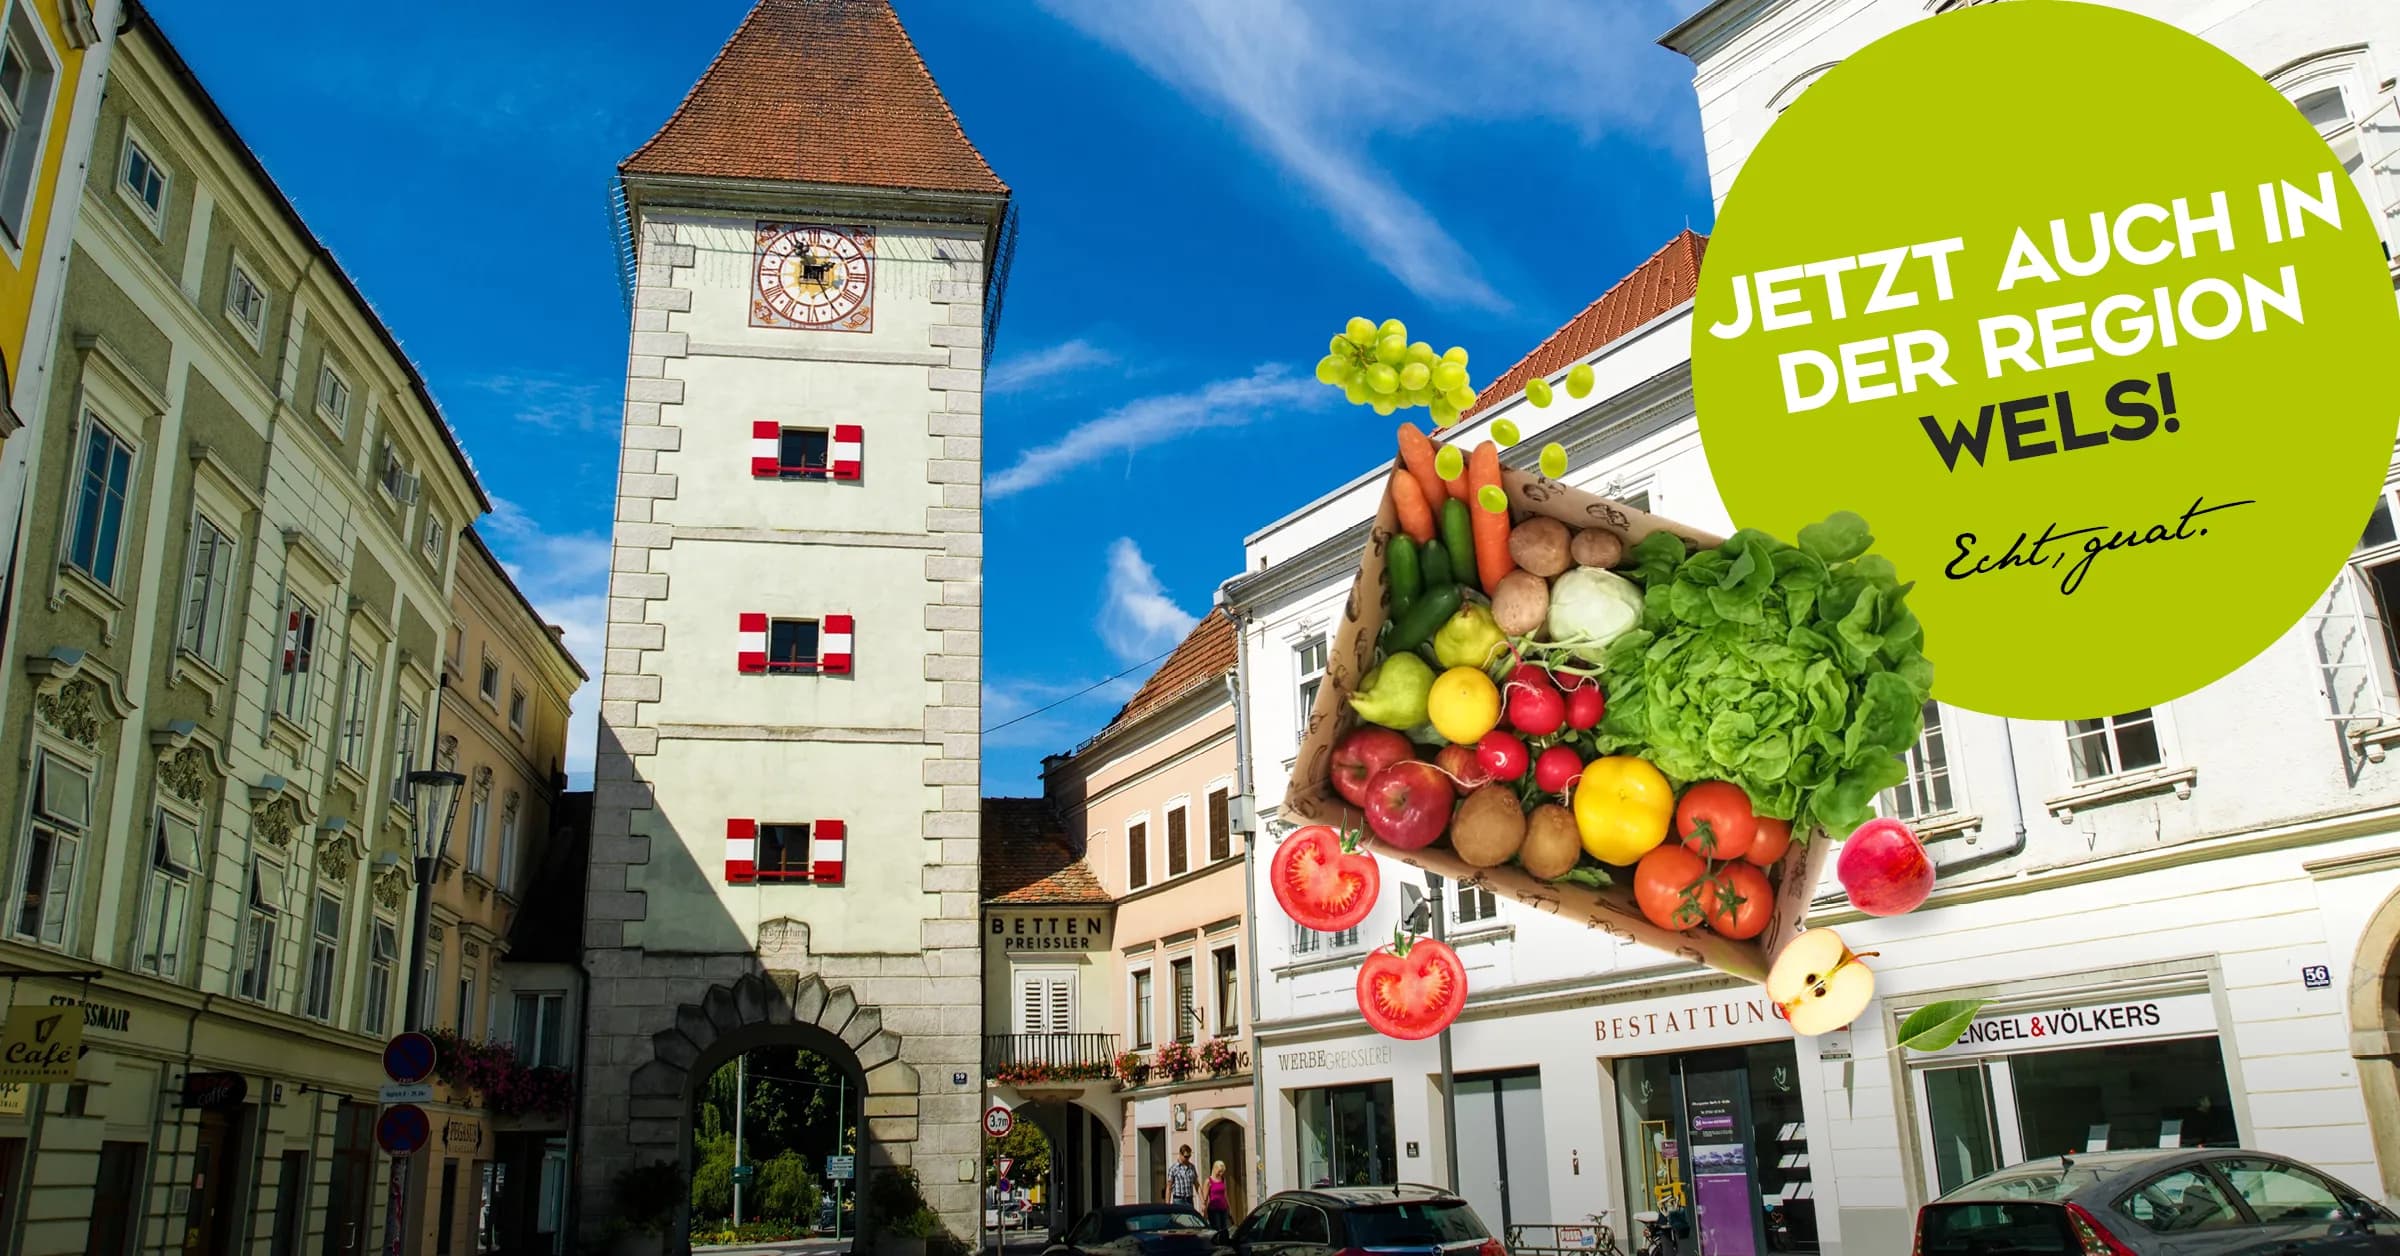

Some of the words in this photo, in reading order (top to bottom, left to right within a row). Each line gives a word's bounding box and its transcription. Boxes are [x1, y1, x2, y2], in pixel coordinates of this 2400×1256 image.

[991, 917, 1102, 935] BETTEN
[1005, 936, 1090, 950] PREISSLER
[2305, 966, 2326, 981] 56
[50, 995, 130, 1033] SSMAIR
[6, 1042, 73, 1068] Café
